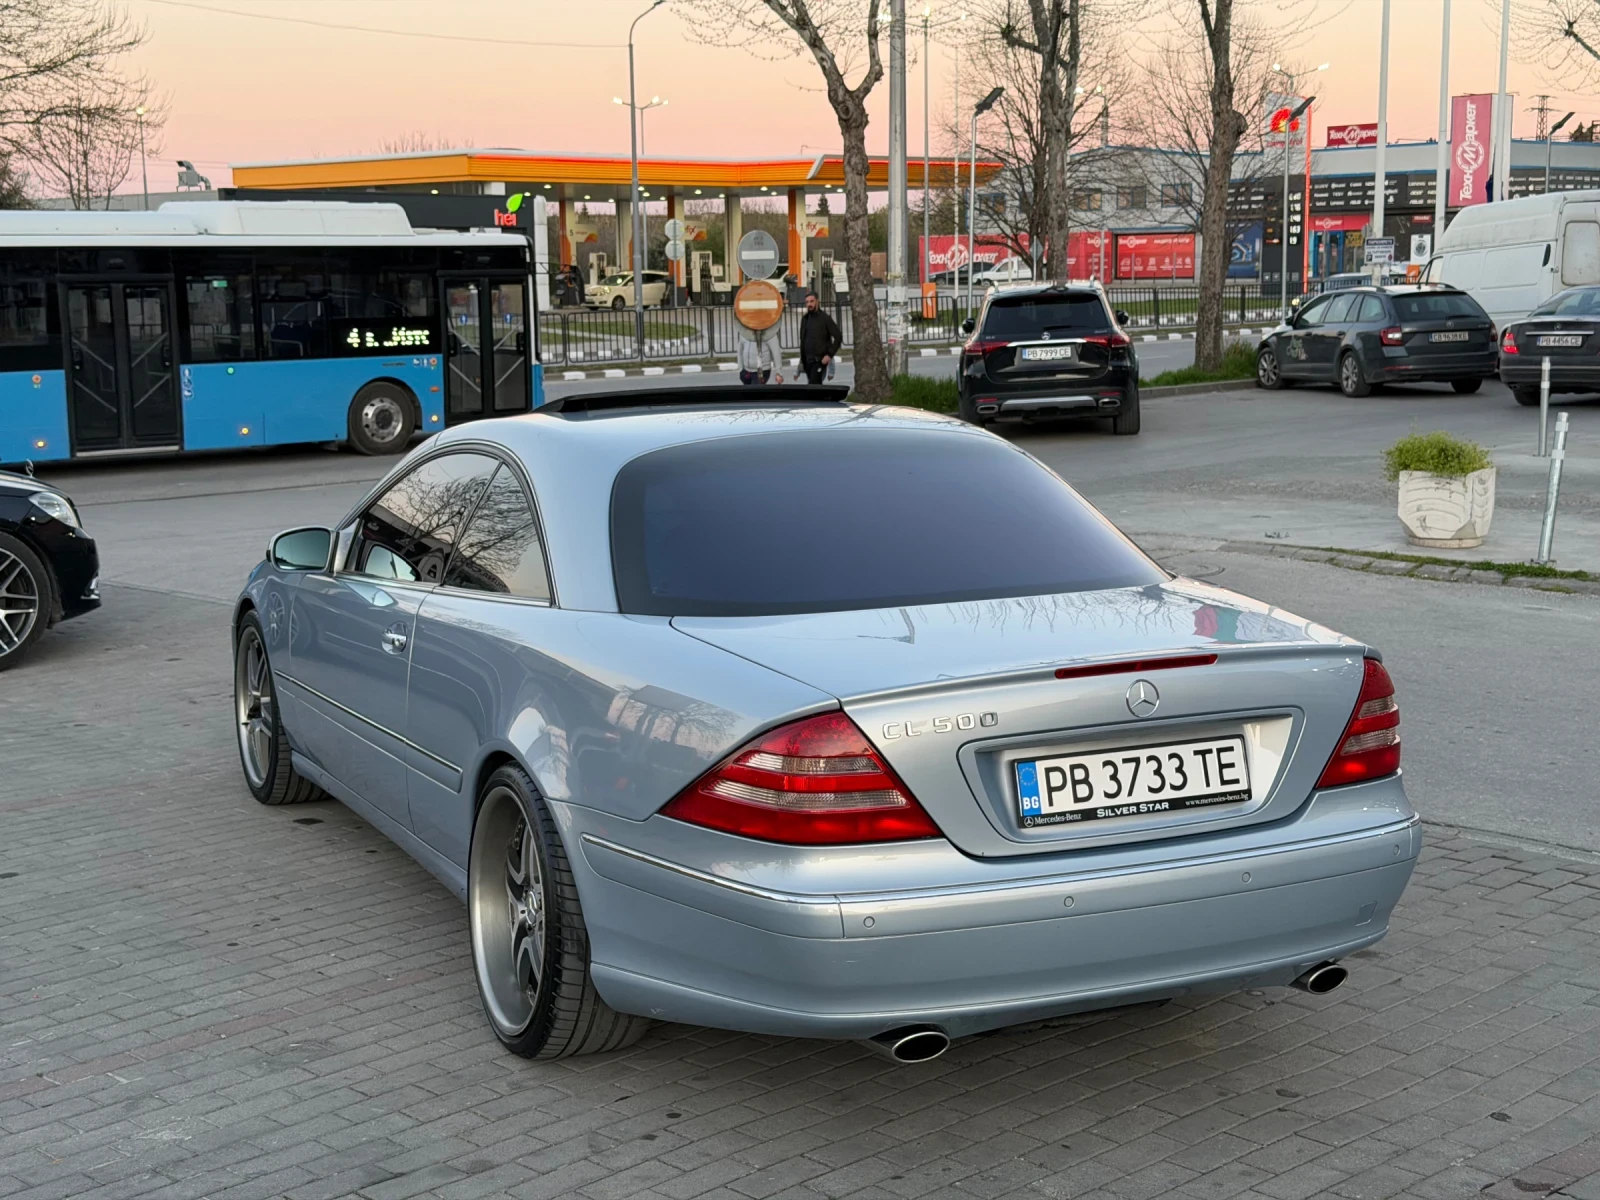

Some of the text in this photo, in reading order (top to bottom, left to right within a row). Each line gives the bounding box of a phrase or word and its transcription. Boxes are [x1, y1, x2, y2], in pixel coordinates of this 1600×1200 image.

[1028, 348, 1070, 358] PB 7999 CE
[883, 711, 998, 739] CL 500
[1044, 746, 1240, 807] PB 3733 TE
[1022, 796, 1039, 810] BG
[1096, 802, 1169, 818] SILVER STAR
[1034, 813, 1082, 825] Mercedes-Benz
